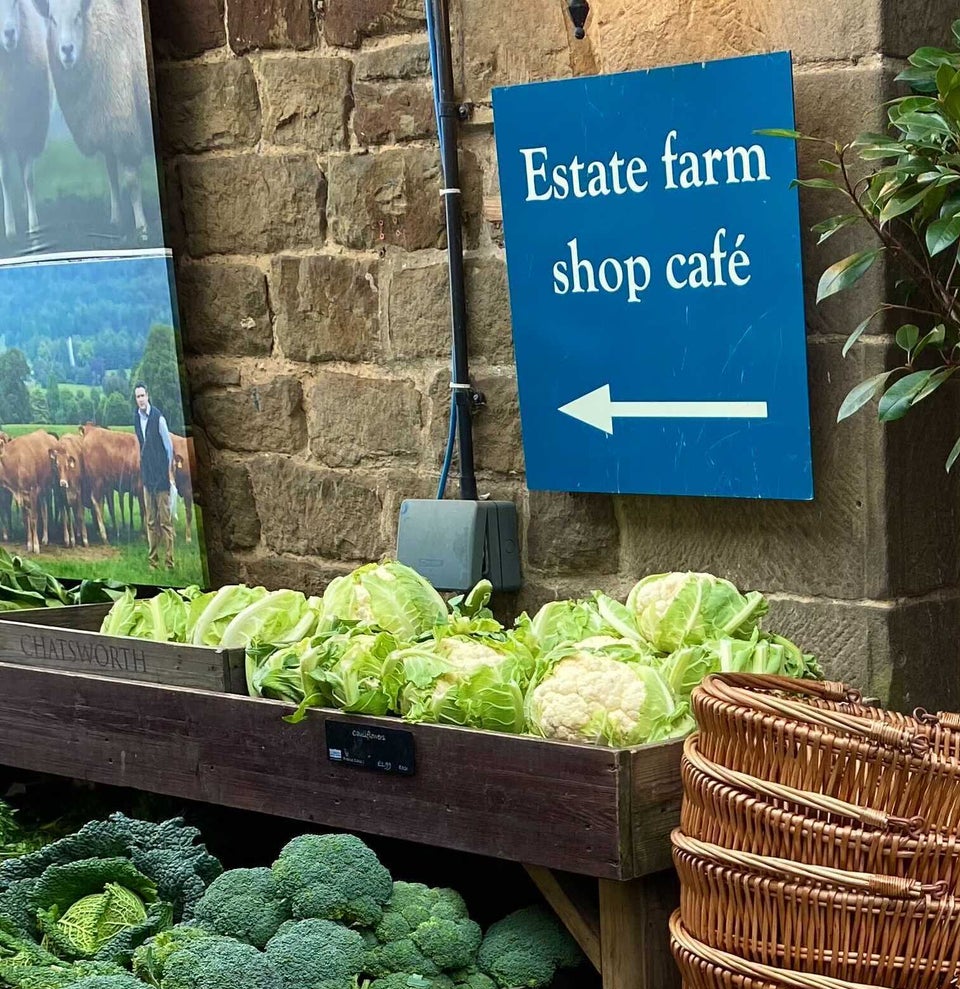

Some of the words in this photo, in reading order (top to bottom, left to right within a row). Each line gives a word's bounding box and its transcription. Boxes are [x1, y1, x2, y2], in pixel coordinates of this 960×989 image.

[519, 146, 648, 202] Estate
[661, 129, 771, 190] farm
[552, 237, 650, 303] shop
[665, 227, 751, 290] café
[20, 633, 147, 673] CHATSWORTH
